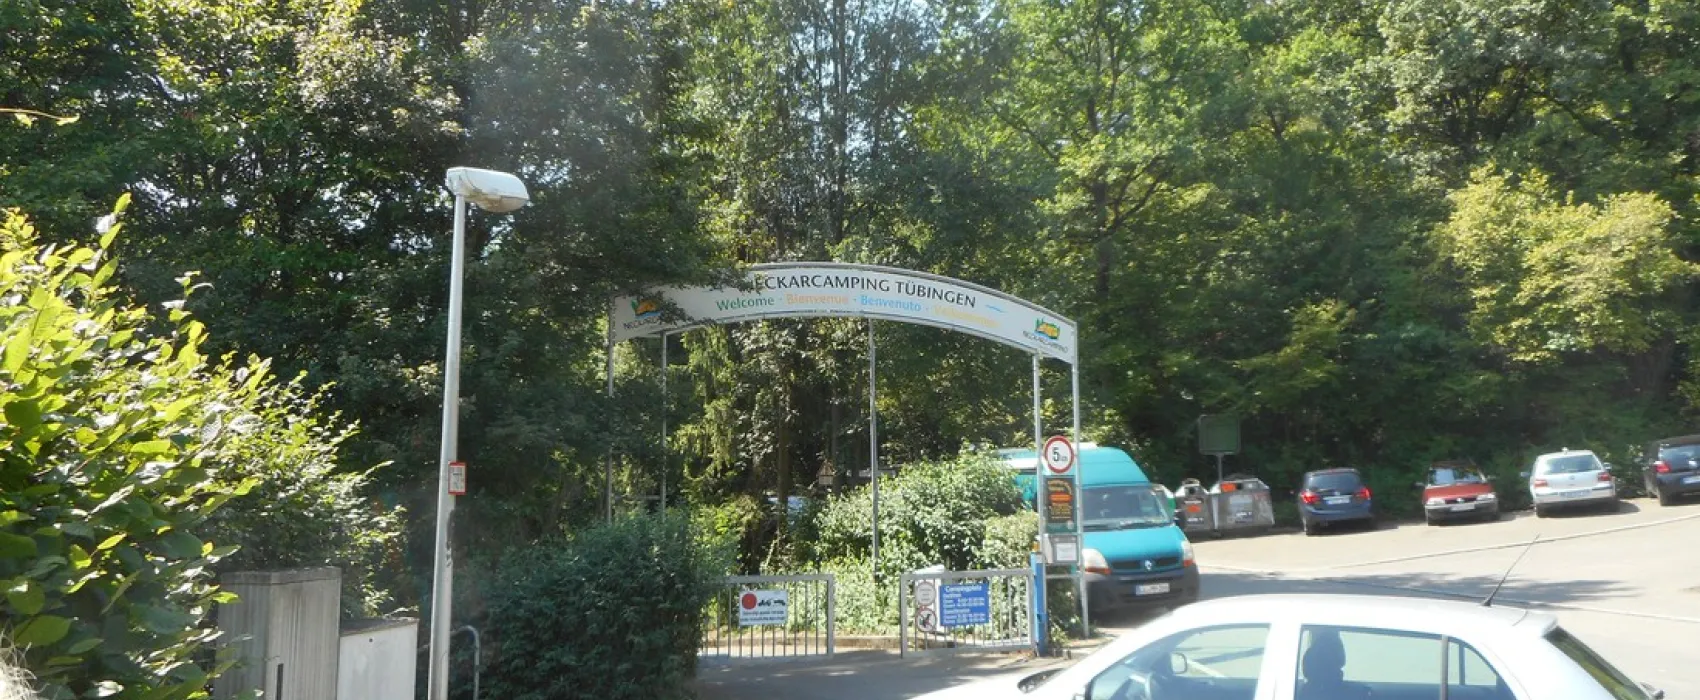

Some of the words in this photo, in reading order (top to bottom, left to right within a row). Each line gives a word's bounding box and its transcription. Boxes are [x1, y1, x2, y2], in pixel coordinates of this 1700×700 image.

[750, 273, 889, 292] ECKARCAMPING
[895, 281, 976, 309] TÜBINGEN
[715, 297, 775, 312] Welcome
[860, 294, 922, 312] Benvenuto
[1052, 446, 1060, 461] 5
